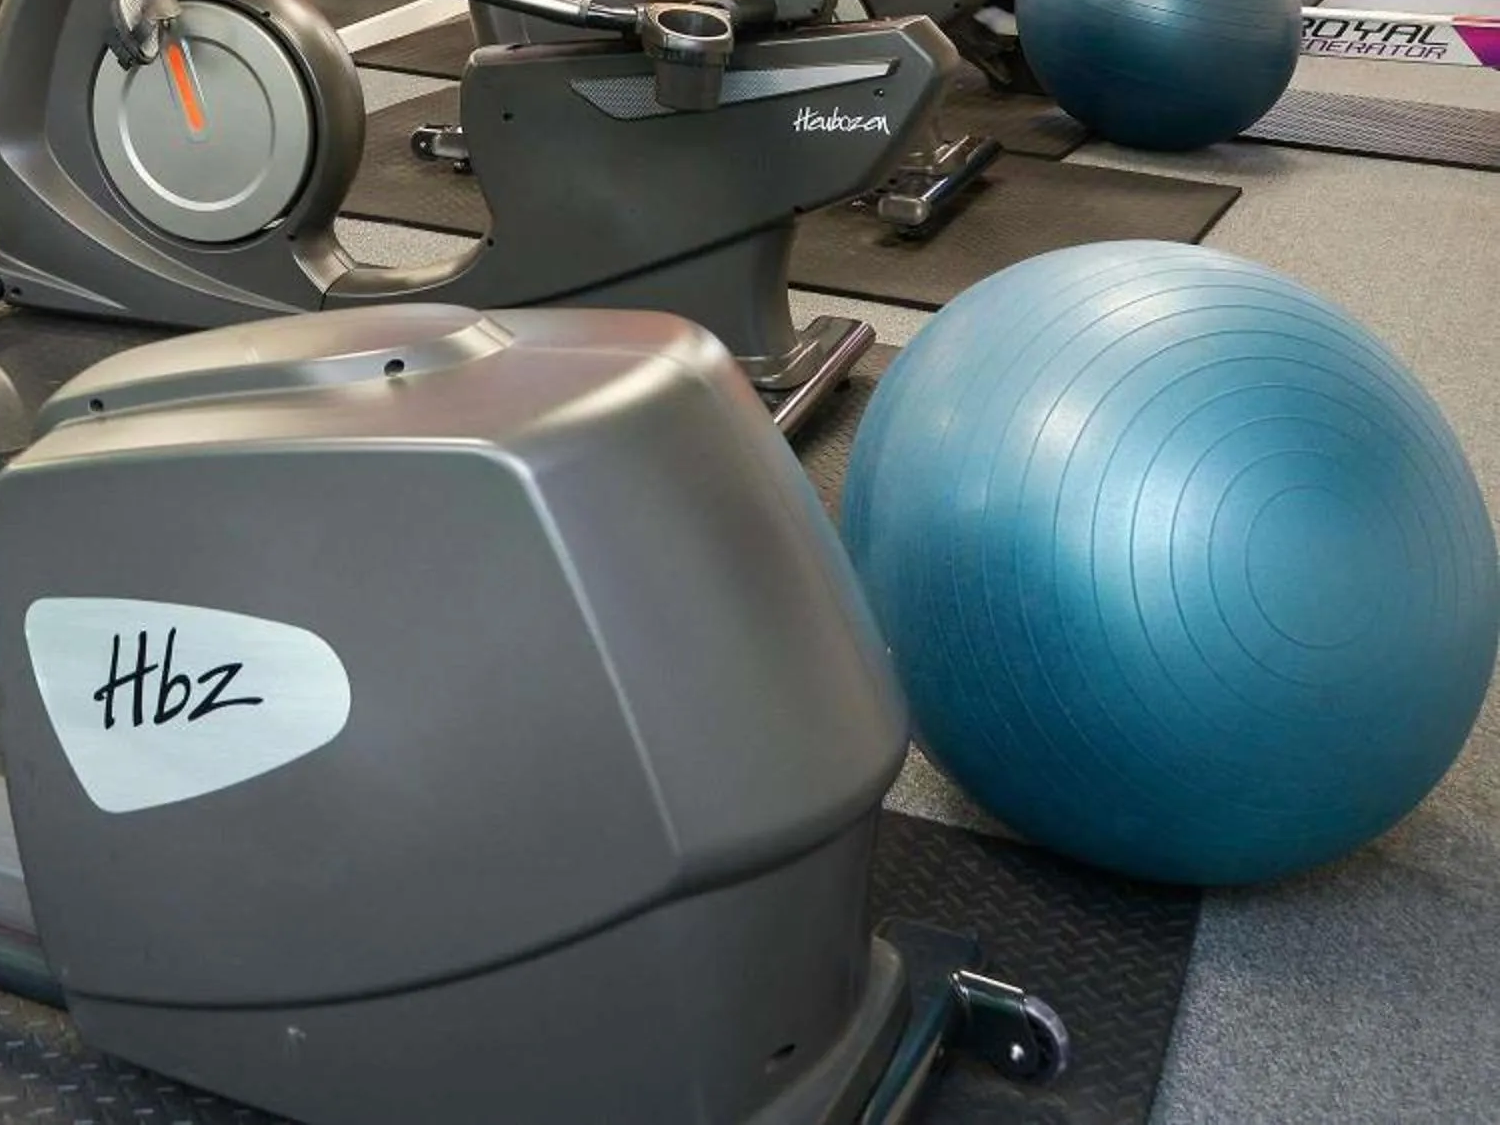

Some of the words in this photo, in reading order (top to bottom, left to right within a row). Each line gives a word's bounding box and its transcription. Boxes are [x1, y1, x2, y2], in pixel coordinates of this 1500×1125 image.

[1299, 38, 1449, 60] NERATOR
[792, 106, 891, 136] Heubozen
[93, 626, 265, 730] Hbz
